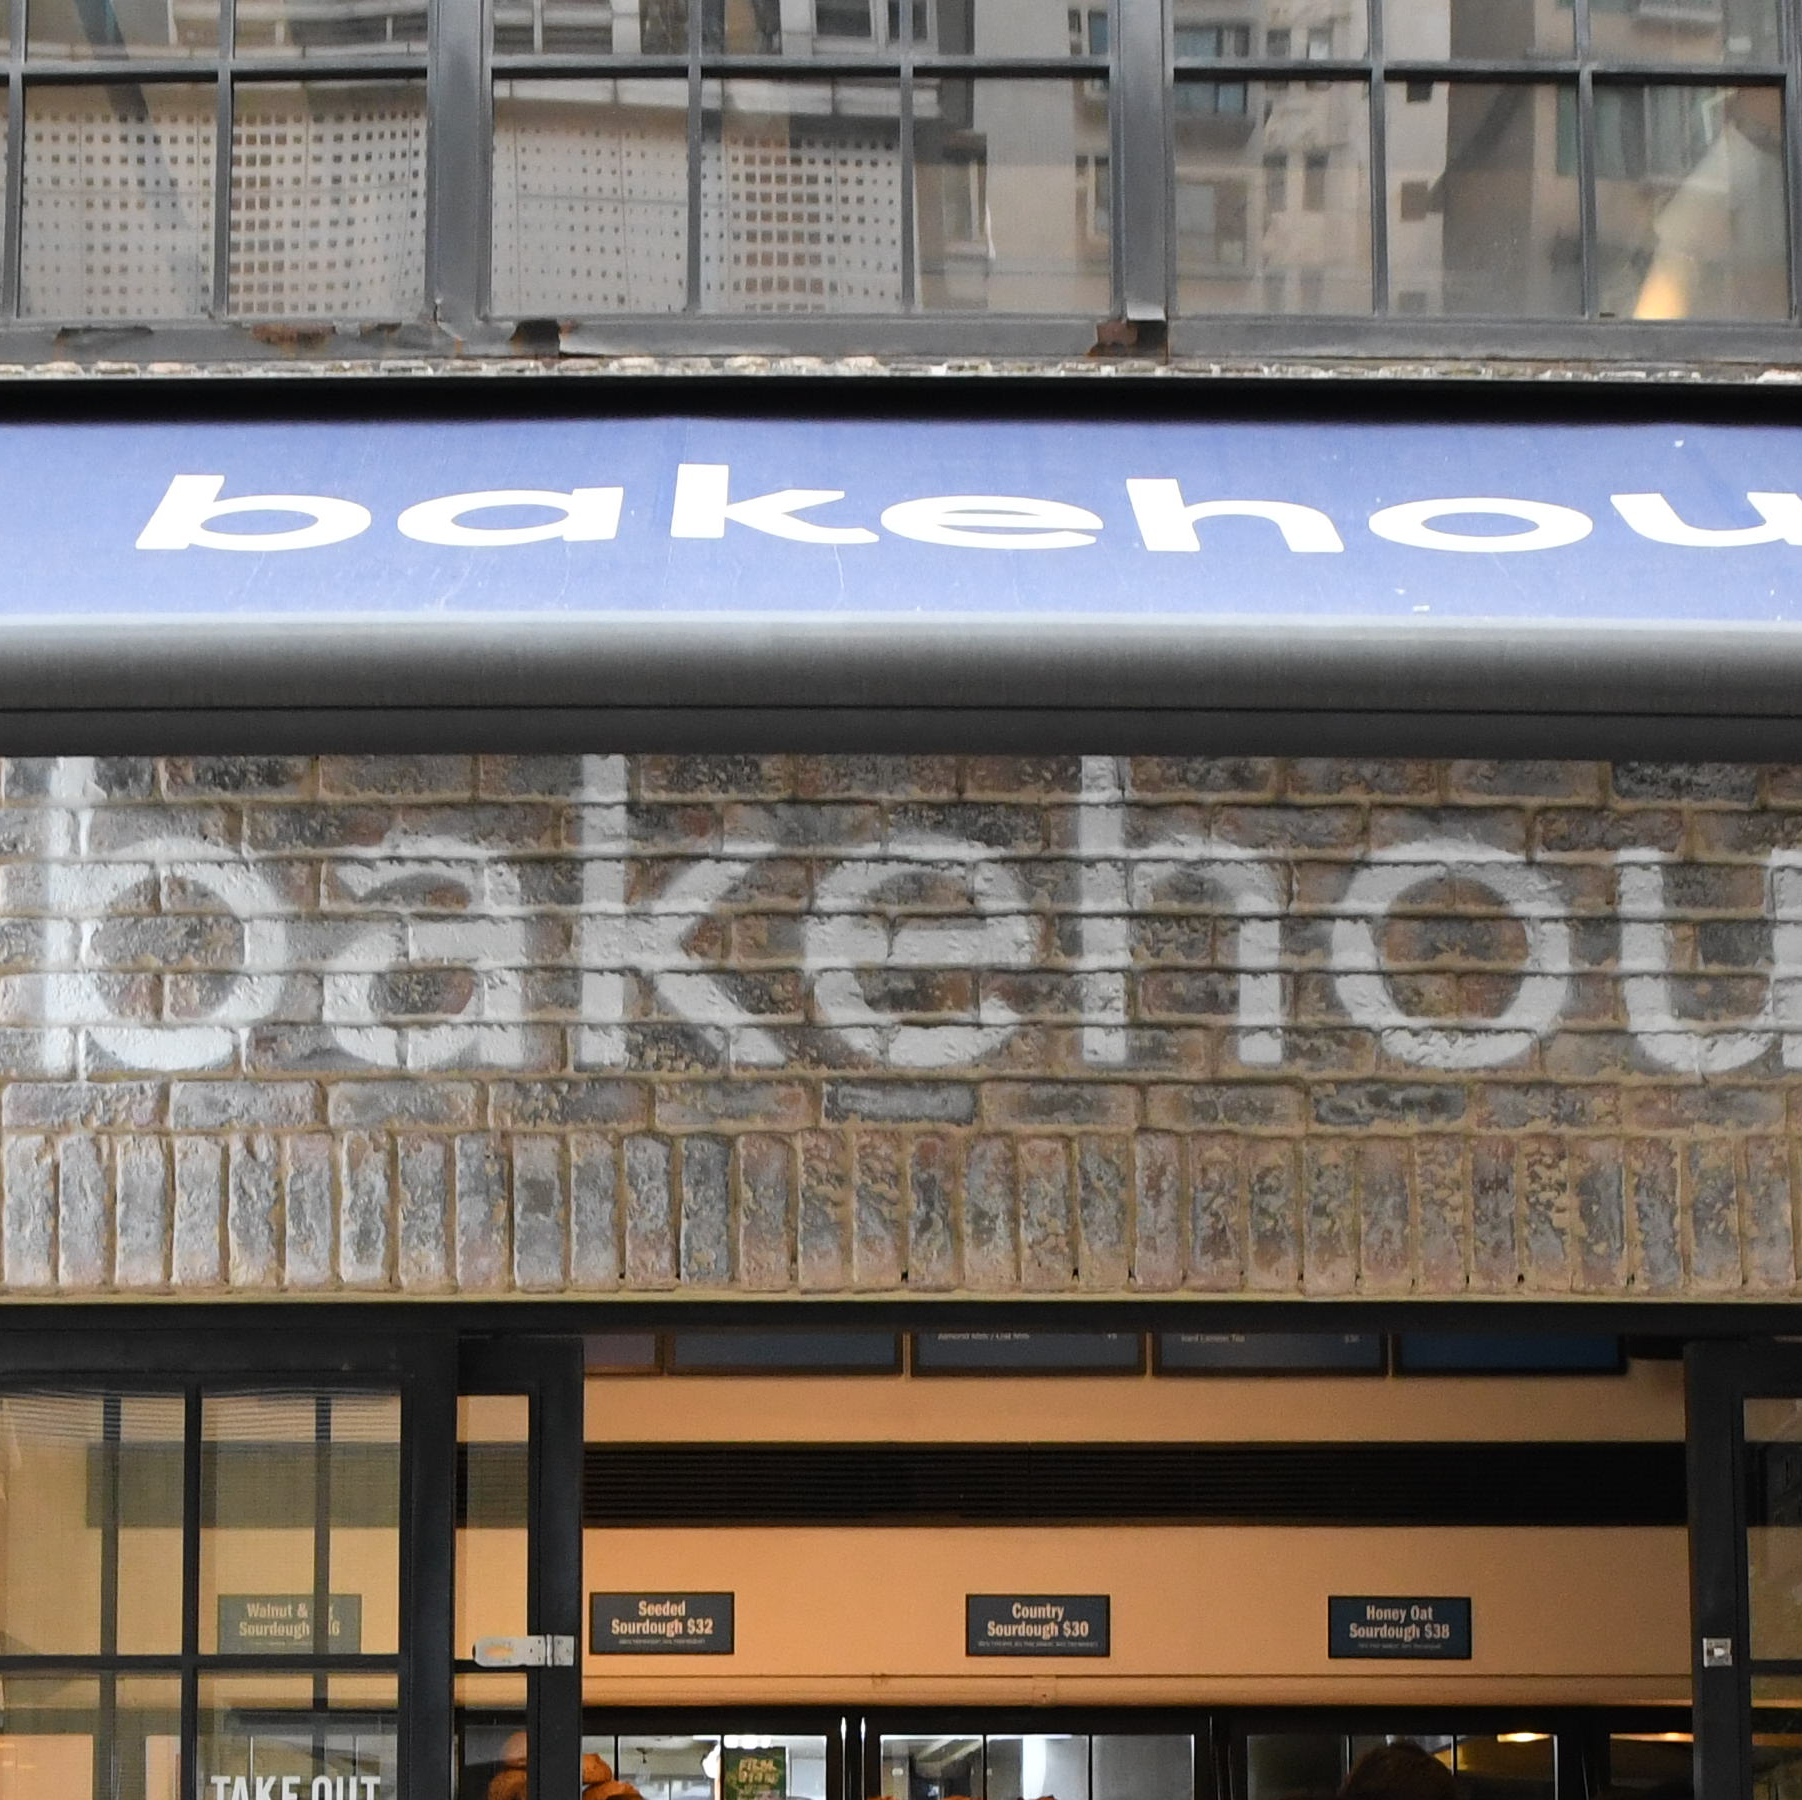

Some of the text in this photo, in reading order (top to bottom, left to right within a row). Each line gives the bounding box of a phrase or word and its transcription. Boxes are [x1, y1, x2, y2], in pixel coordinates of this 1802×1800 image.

[247, 1603, 308, 1618] Walnut &
[638, 1600, 686, 1616] Seeded
[1012, 1602, 1064, 1622] Country
[1366, 1605, 1433, 1623] Honey Oat
[239, 1621, 310, 1640] Sourdough
[611, 1618, 713, 1637] Sourdough $32
[987, 1620, 1089, 1640] Sourdough $30
[1349, 1623, 1450, 1642] Sourdough $38
